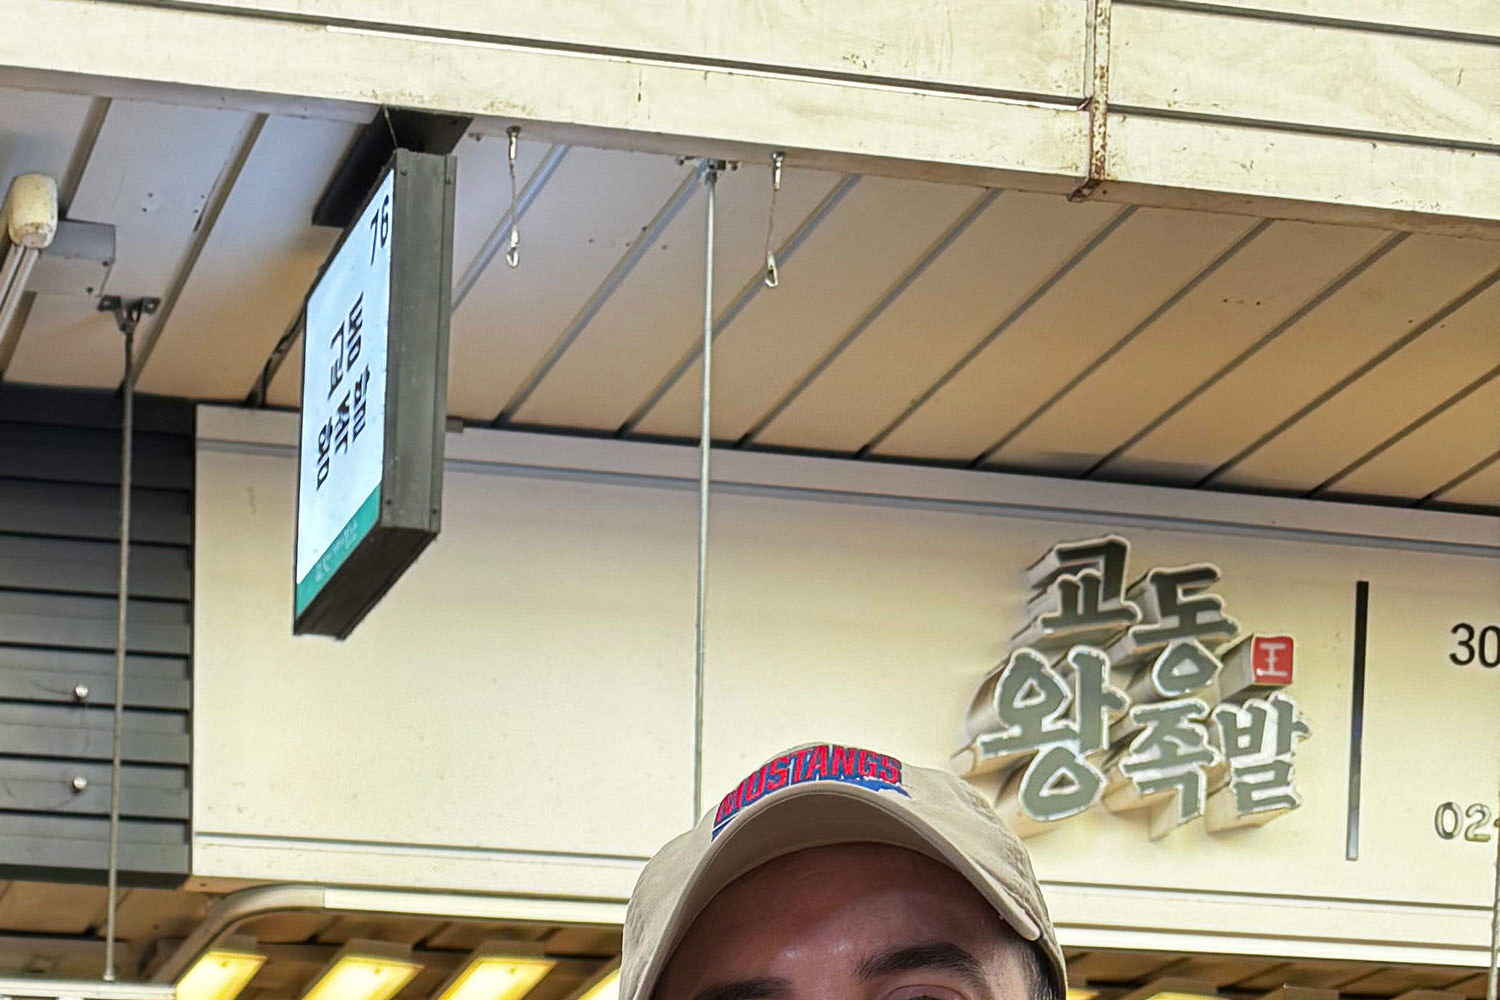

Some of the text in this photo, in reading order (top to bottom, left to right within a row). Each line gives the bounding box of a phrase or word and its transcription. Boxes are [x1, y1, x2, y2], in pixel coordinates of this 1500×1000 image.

[369, 193, 390, 266] 76
[327, 291, 364, 401] 교동
[316, 364, 370, 491] 왕족발
[1032, 533, 1242, 698] 교동
[713, 744, 903, 827] MUSTANGS
[974, 644, 1314, 823] 왕족발
